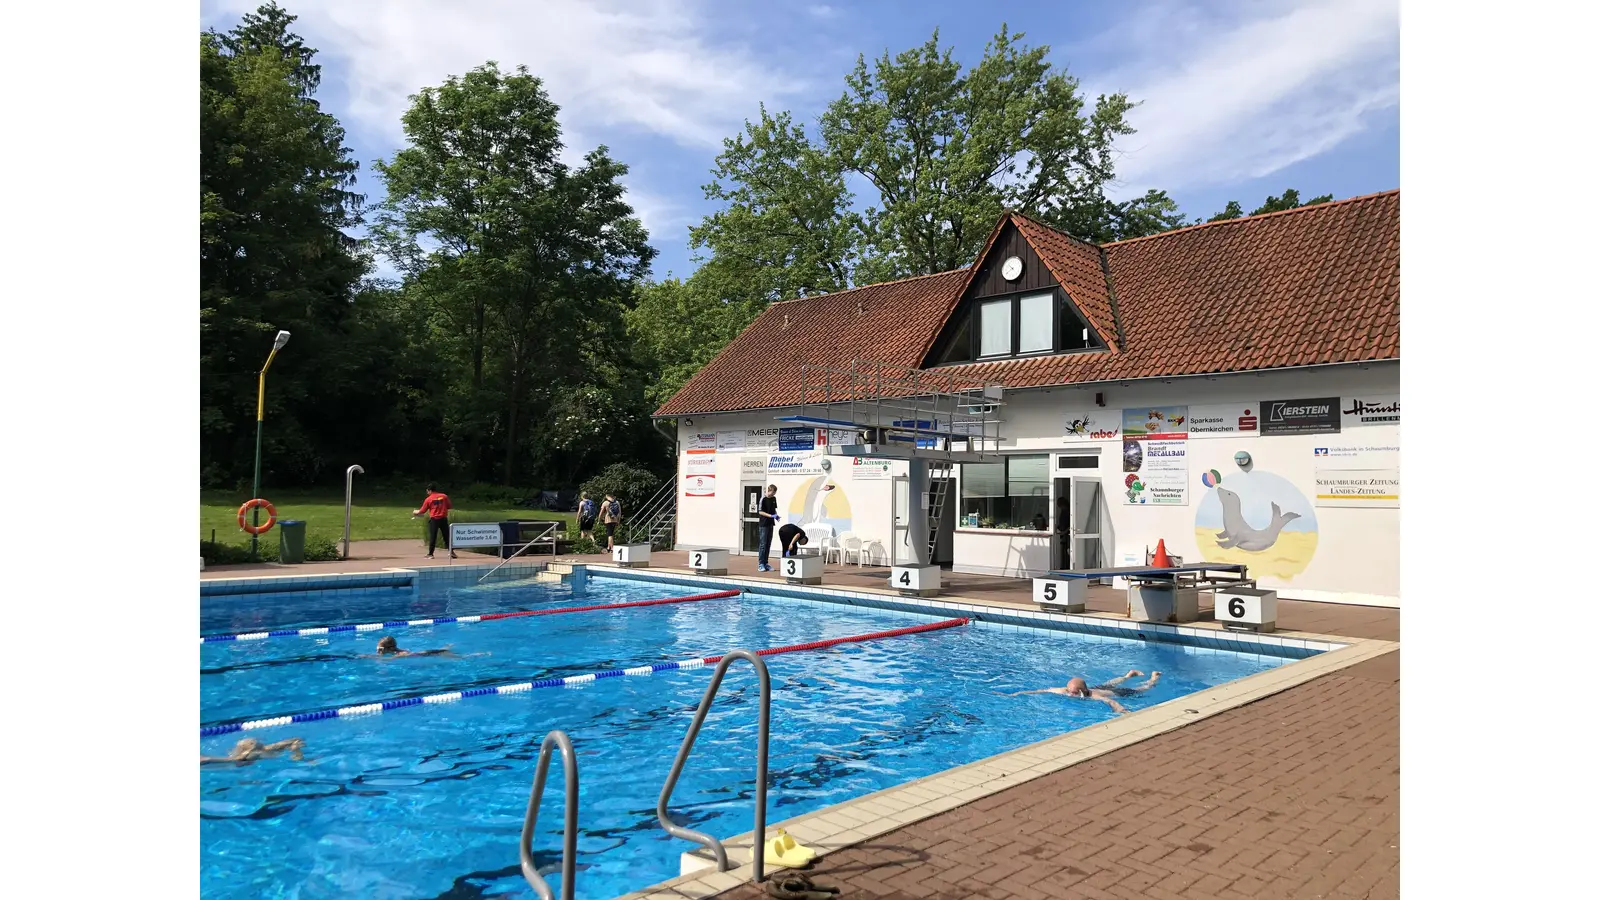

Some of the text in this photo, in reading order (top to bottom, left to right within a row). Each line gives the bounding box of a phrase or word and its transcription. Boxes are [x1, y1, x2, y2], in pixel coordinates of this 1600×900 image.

[1269, 402, 1330, 421] KIERSTEIN
[752, 428, 779, 436] MEIER
[1090, 428, 1113, 439] rabe
[743, 460, 764, 468] HERREN
[770, 455, 795, 463] Möbel
[1370, 478, 1399, 486] ZEITUNG
[617, 548, 623, 560] 1
[694, 553, 702, 567] 2
[787, 559, 796, 575] 3
[899, 570, 911, 586] 4
[1043, 582, 1057, 601] 5
[1228, 597, 1246, 618] 6
